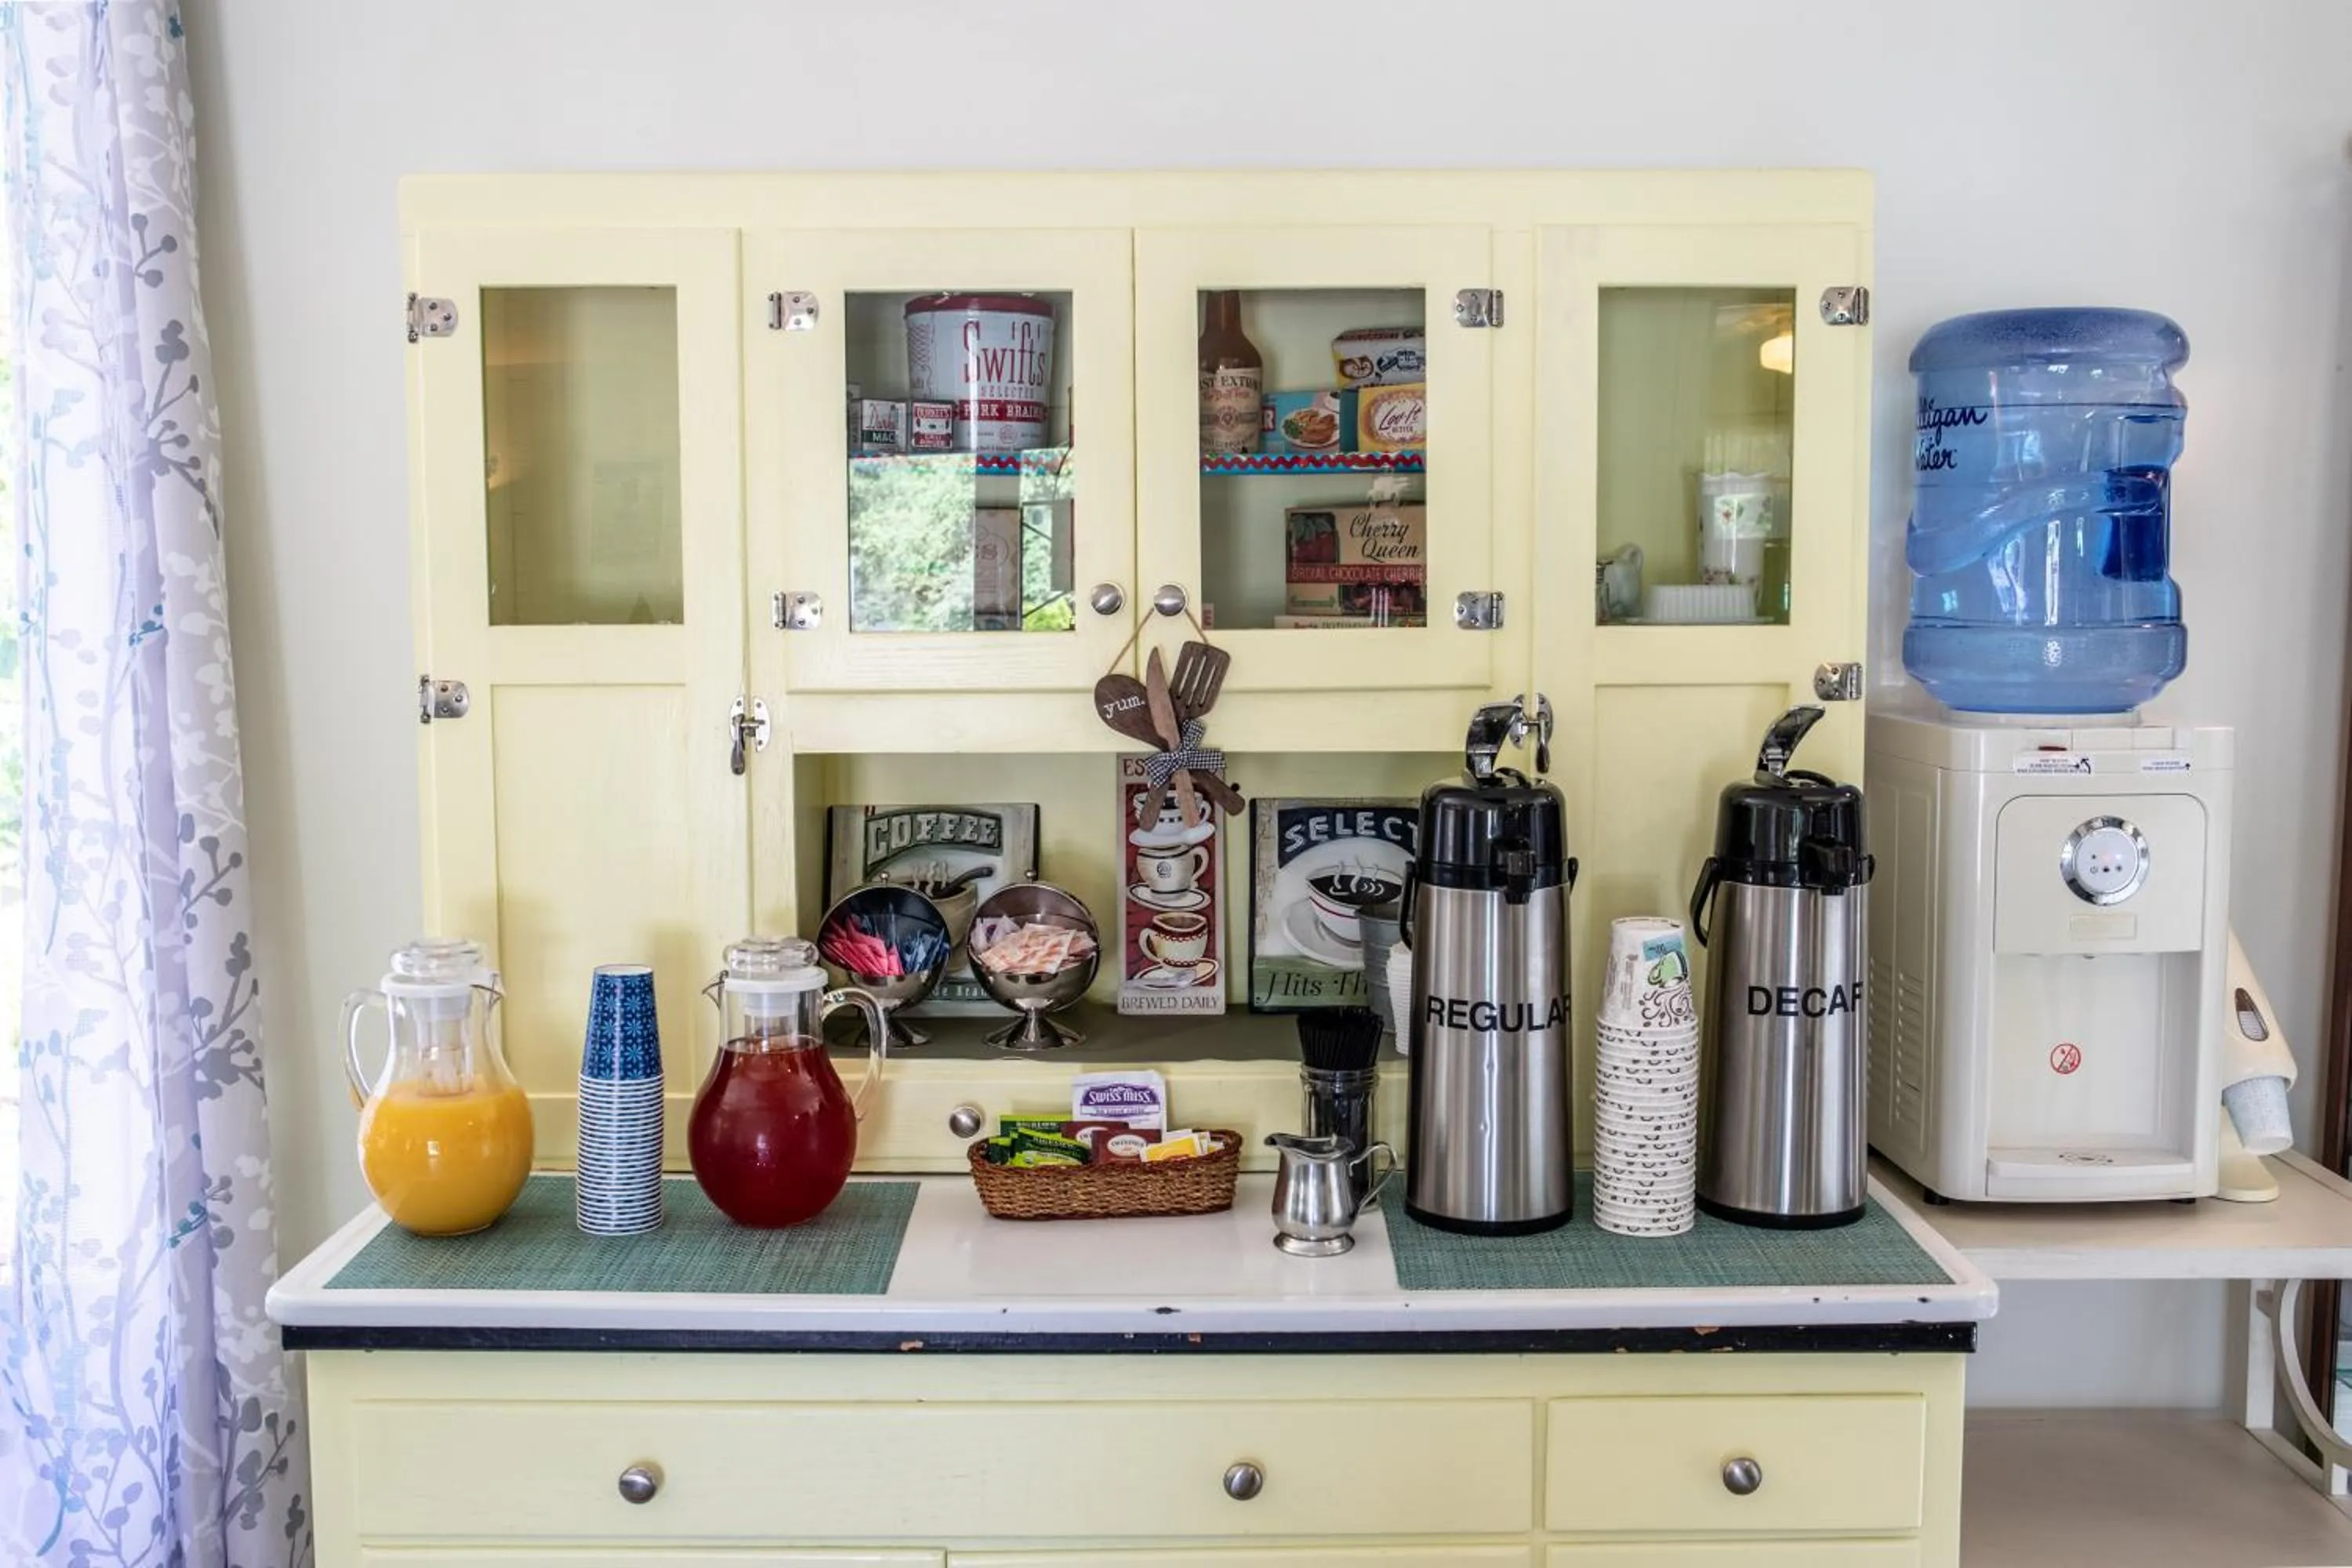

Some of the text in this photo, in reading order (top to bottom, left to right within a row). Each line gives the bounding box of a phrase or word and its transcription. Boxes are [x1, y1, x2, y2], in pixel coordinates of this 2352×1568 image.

[964, 321, 1045, 387] Swift's
[964, 404, 1000, 417] PRK
[1348, 513, 1410, 543] Cherry
[1361, 539, 1420, 563] Queen
[1103, 695, 1145, 719] yum.
[867, 813, 996, 866] COFFEE
[1122, 996, 1219, 1009] BREWED DAILY
[1748, 981, 1864, 1018] DECAF
